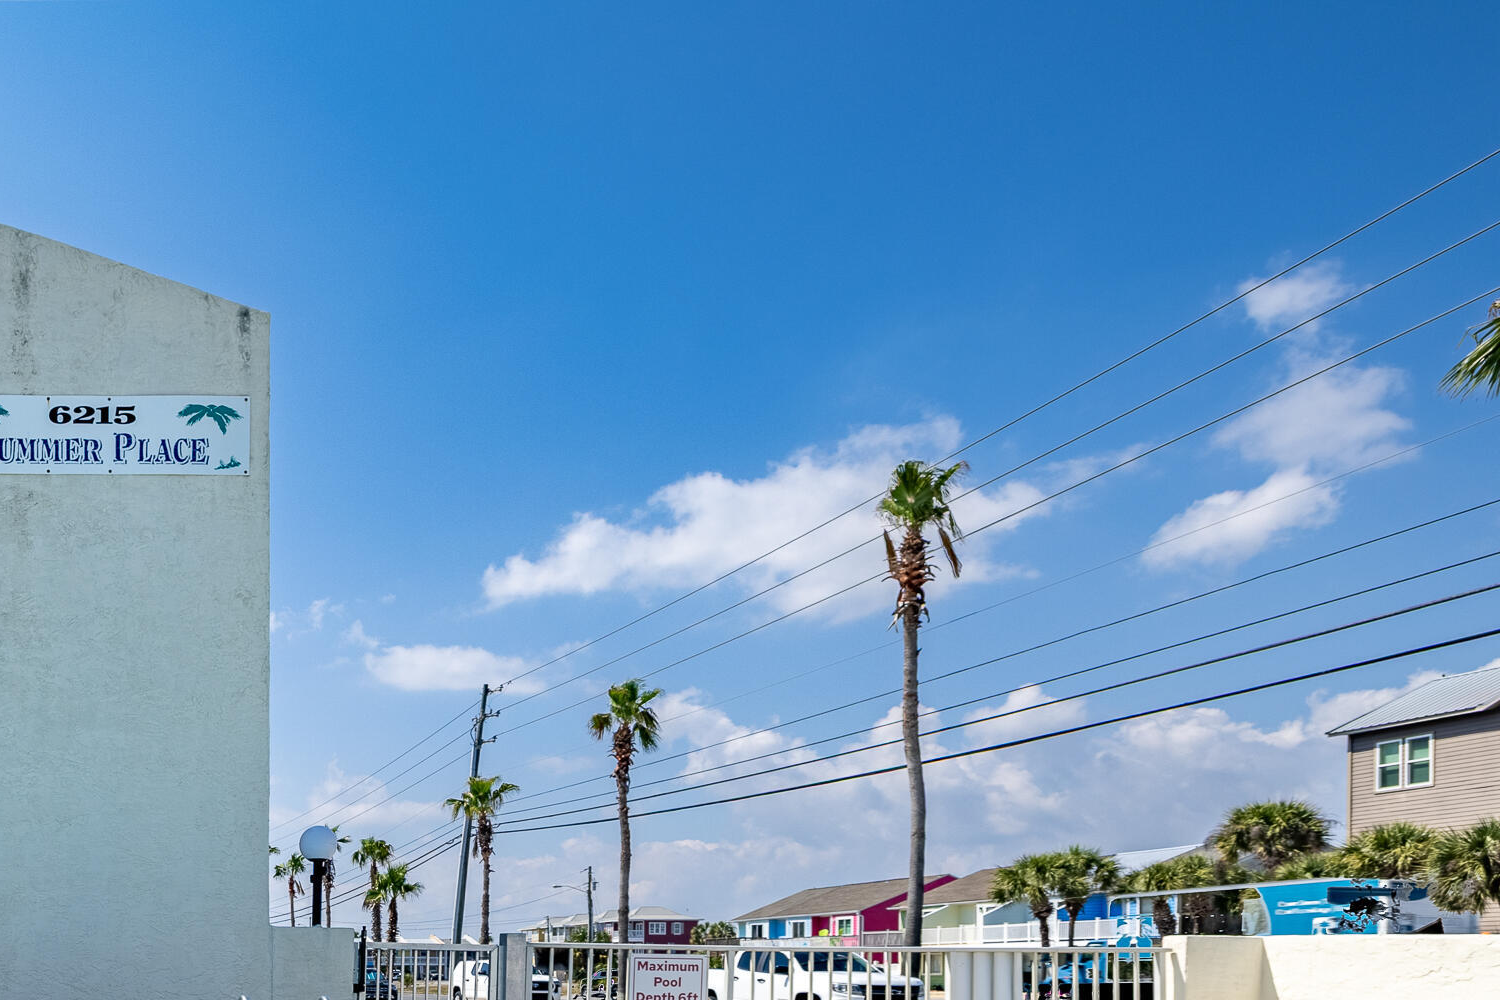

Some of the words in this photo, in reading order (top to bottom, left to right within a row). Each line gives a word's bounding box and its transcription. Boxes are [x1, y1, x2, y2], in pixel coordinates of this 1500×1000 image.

[49, 405, 136, 425] 6215
[113, 431, 210, 465] PLACE
[637, 960, 699, 972] Maximum
[653, 977, 682, 987] Pool
